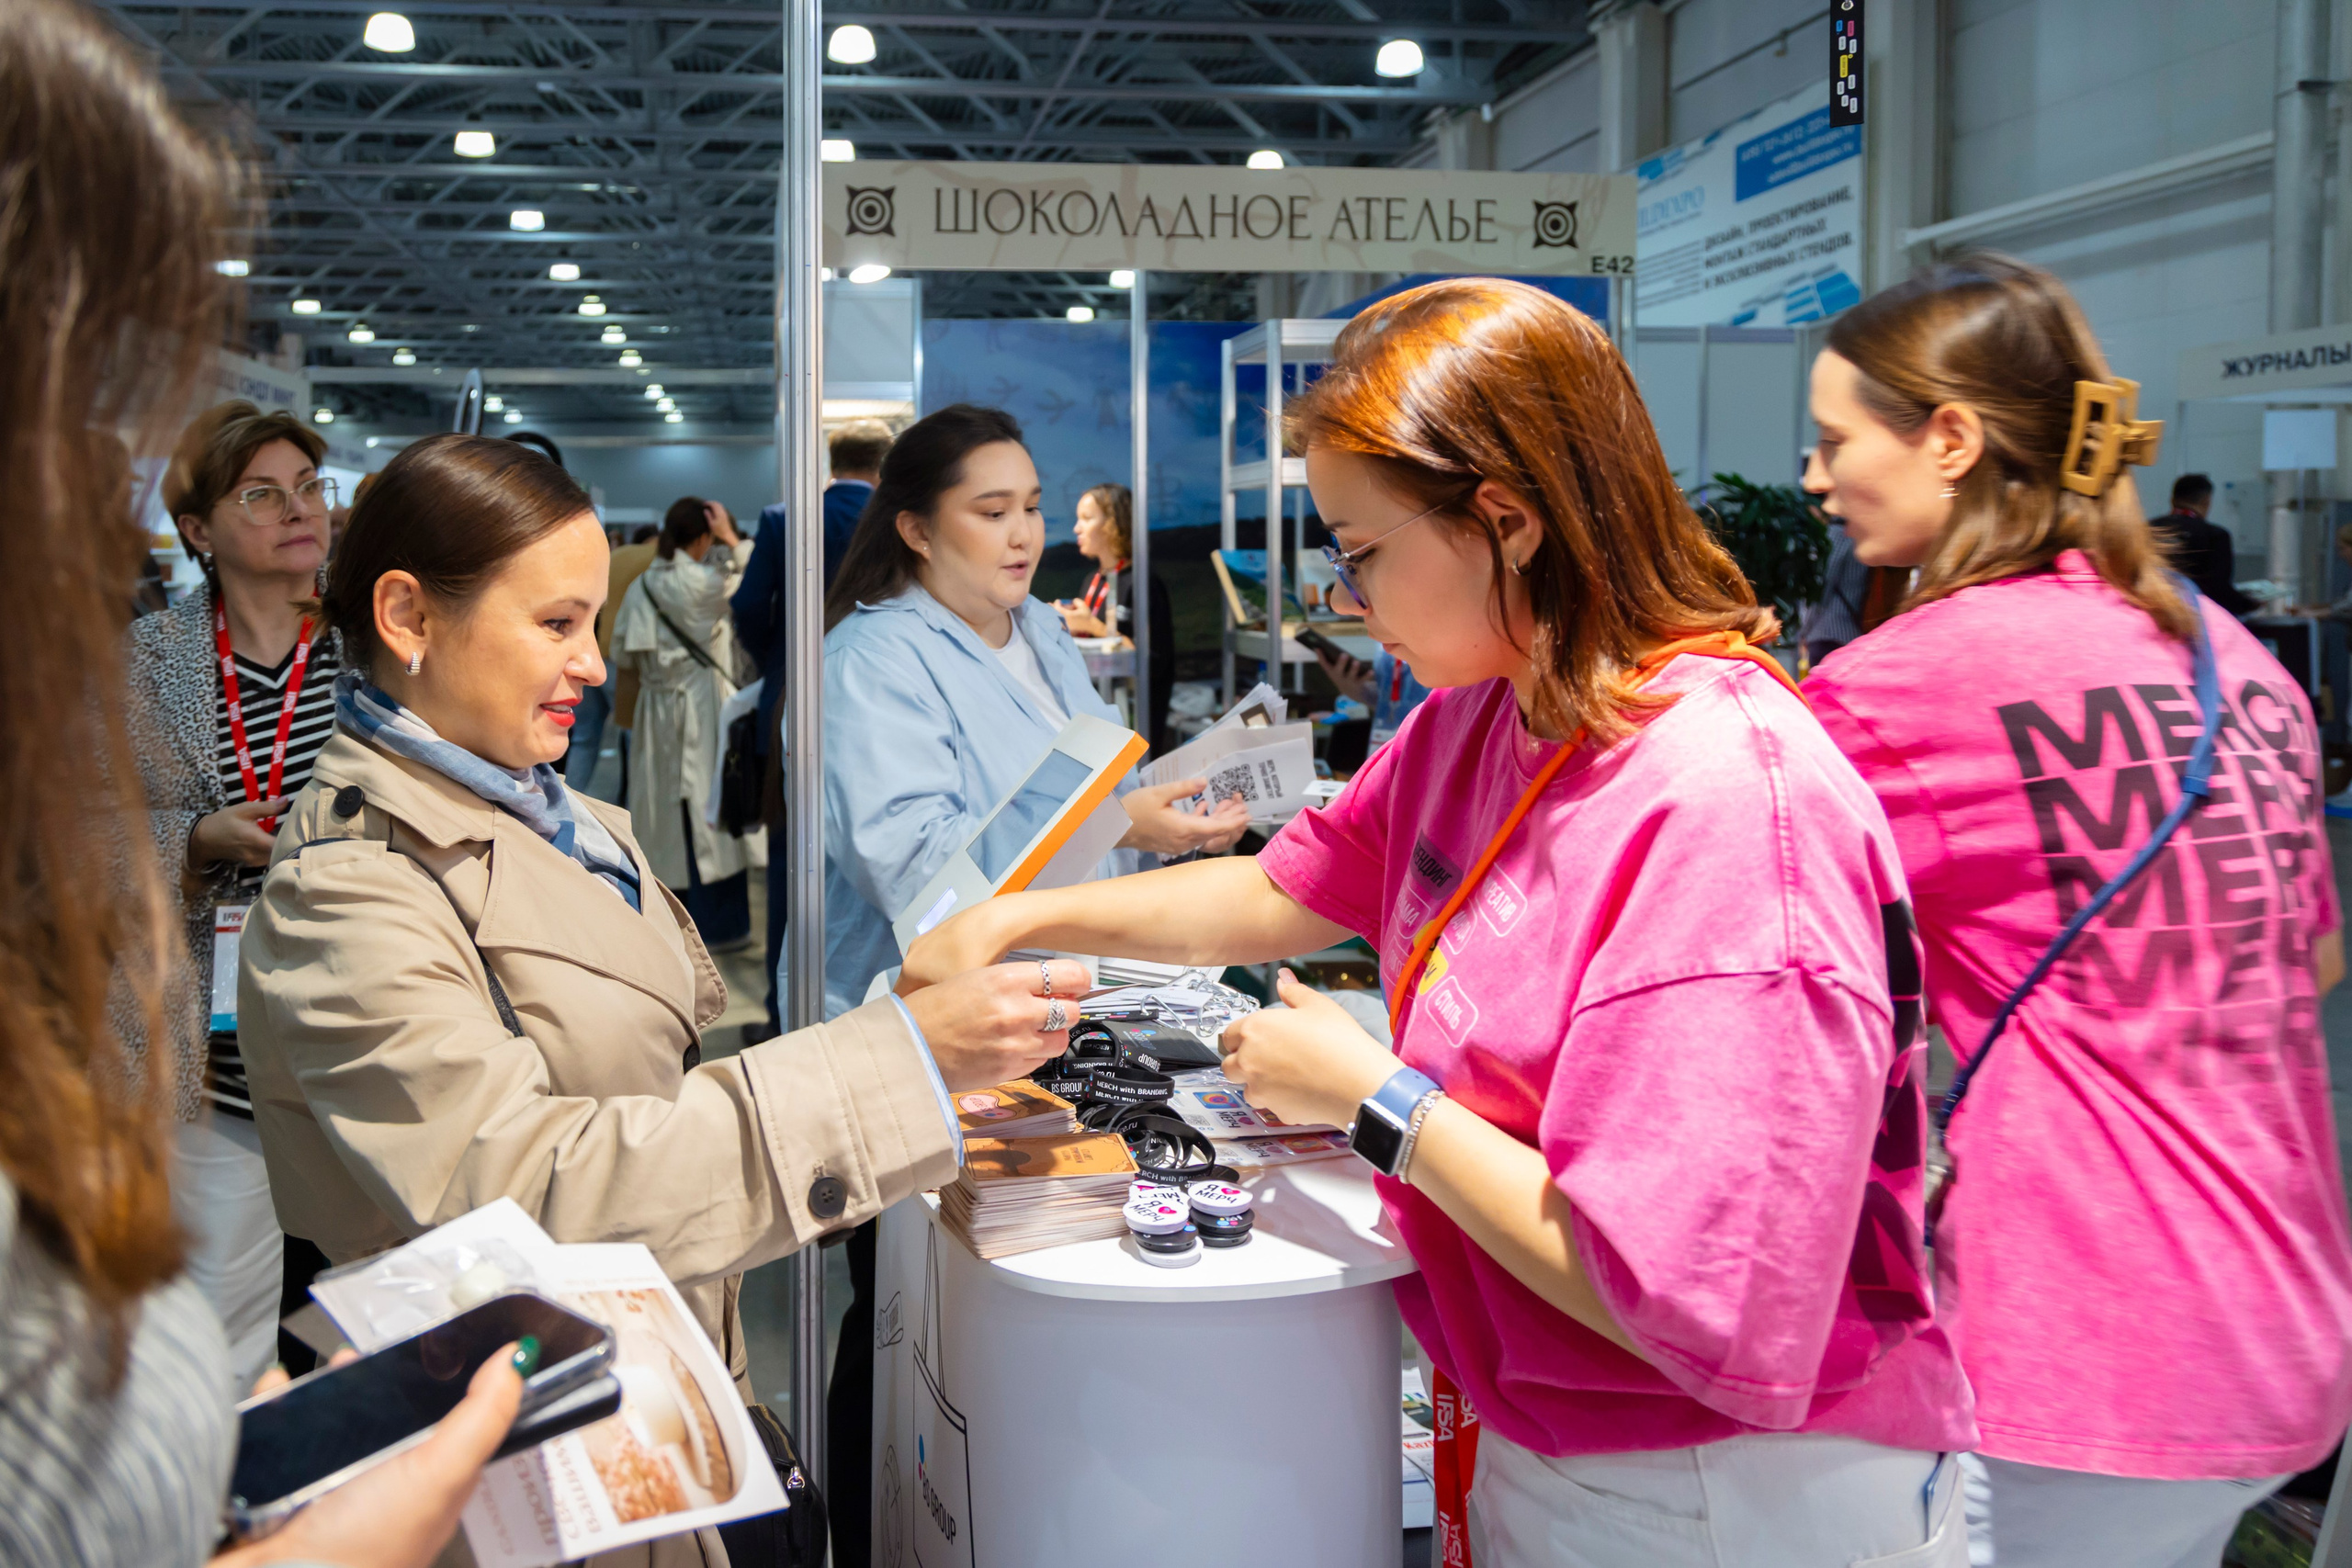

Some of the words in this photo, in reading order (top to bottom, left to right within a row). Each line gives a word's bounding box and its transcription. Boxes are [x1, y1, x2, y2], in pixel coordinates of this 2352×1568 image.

[933, 186, 1312, 240] ШОКОЛАДНОЕ
[1329, 197, 1498, 243] АТЕЛЬЕ
[1591, 254, 1634, 274] E42
[2221, 342, 2352, 379] ЖУРНАЛЫ
[1434, 988, 1464, 1031] СТИЛЬ
[1051, 1083, 1059, 1093] BS
[1060, 1082, 1082, 1092] GROU
[1097, 1080, 1118, 1091] MERCH
[1120, 1086, 1136, 1094] with
[1216, 1111, 1241, 1129] МЕРЧ
[1137, 1168, 1159, 1180] ERCH
[1160, 1174, 1176, 1182] with
[1195, 1190, 1238, 1203] МЕРЧ
[1129, 1204, 1165, 1222] МЕРЧ
[931, 1487, 956, 1545] GROUP
